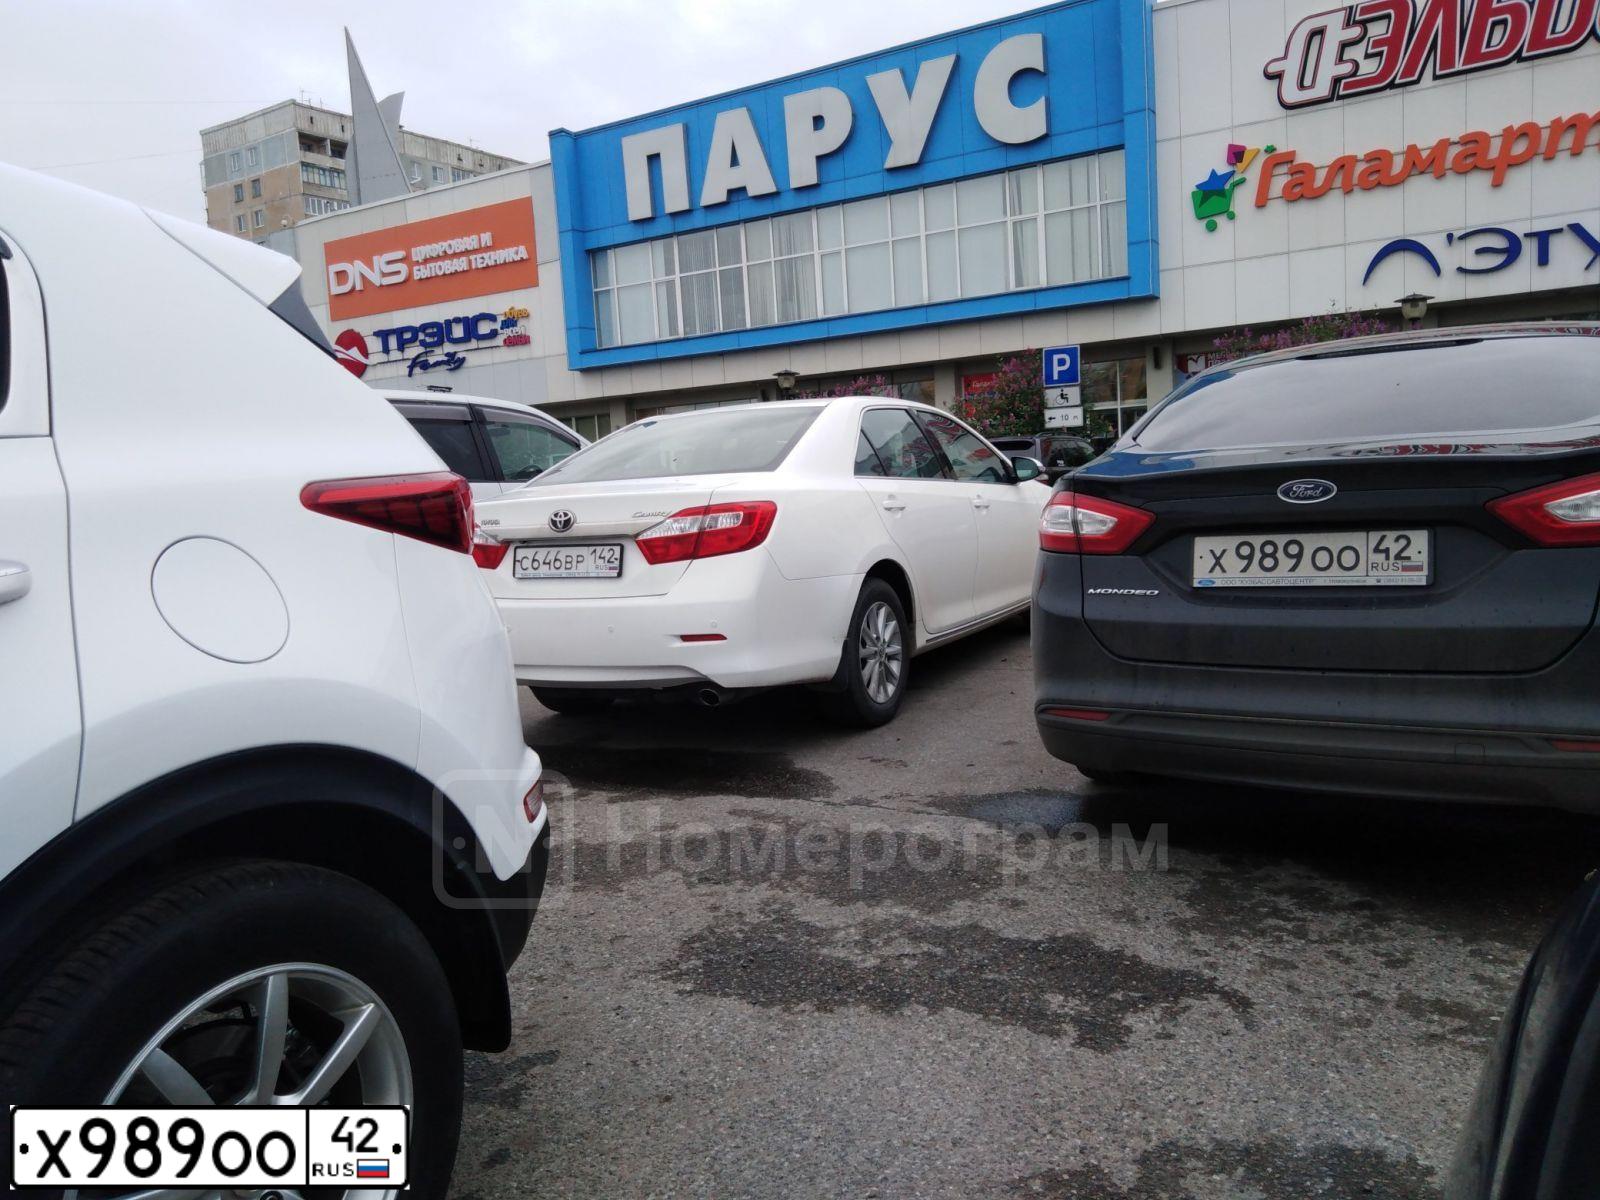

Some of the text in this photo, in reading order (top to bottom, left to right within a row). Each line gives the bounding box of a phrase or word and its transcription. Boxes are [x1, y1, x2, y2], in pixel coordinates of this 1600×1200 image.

[621, 33, 1049, 222] ПАРУС
[411, 232, 493, 262] ЦИФРОВАЯ И
[328, 250, 409, 296] DNS
[413, 245, 529, 280] БЫТОВАЯ ТЕХНИКА
[1052, 353, 1071, 381] P
[1289, 483, 1323, 499] Ford
[519, 548, 615, 572] С646ВР 142
[1208, 534, 1412, 574] Х989ОО 42
[1370, 561, 1400, 572] RUS
[1087, 588, 1160, 596] MONDEO
